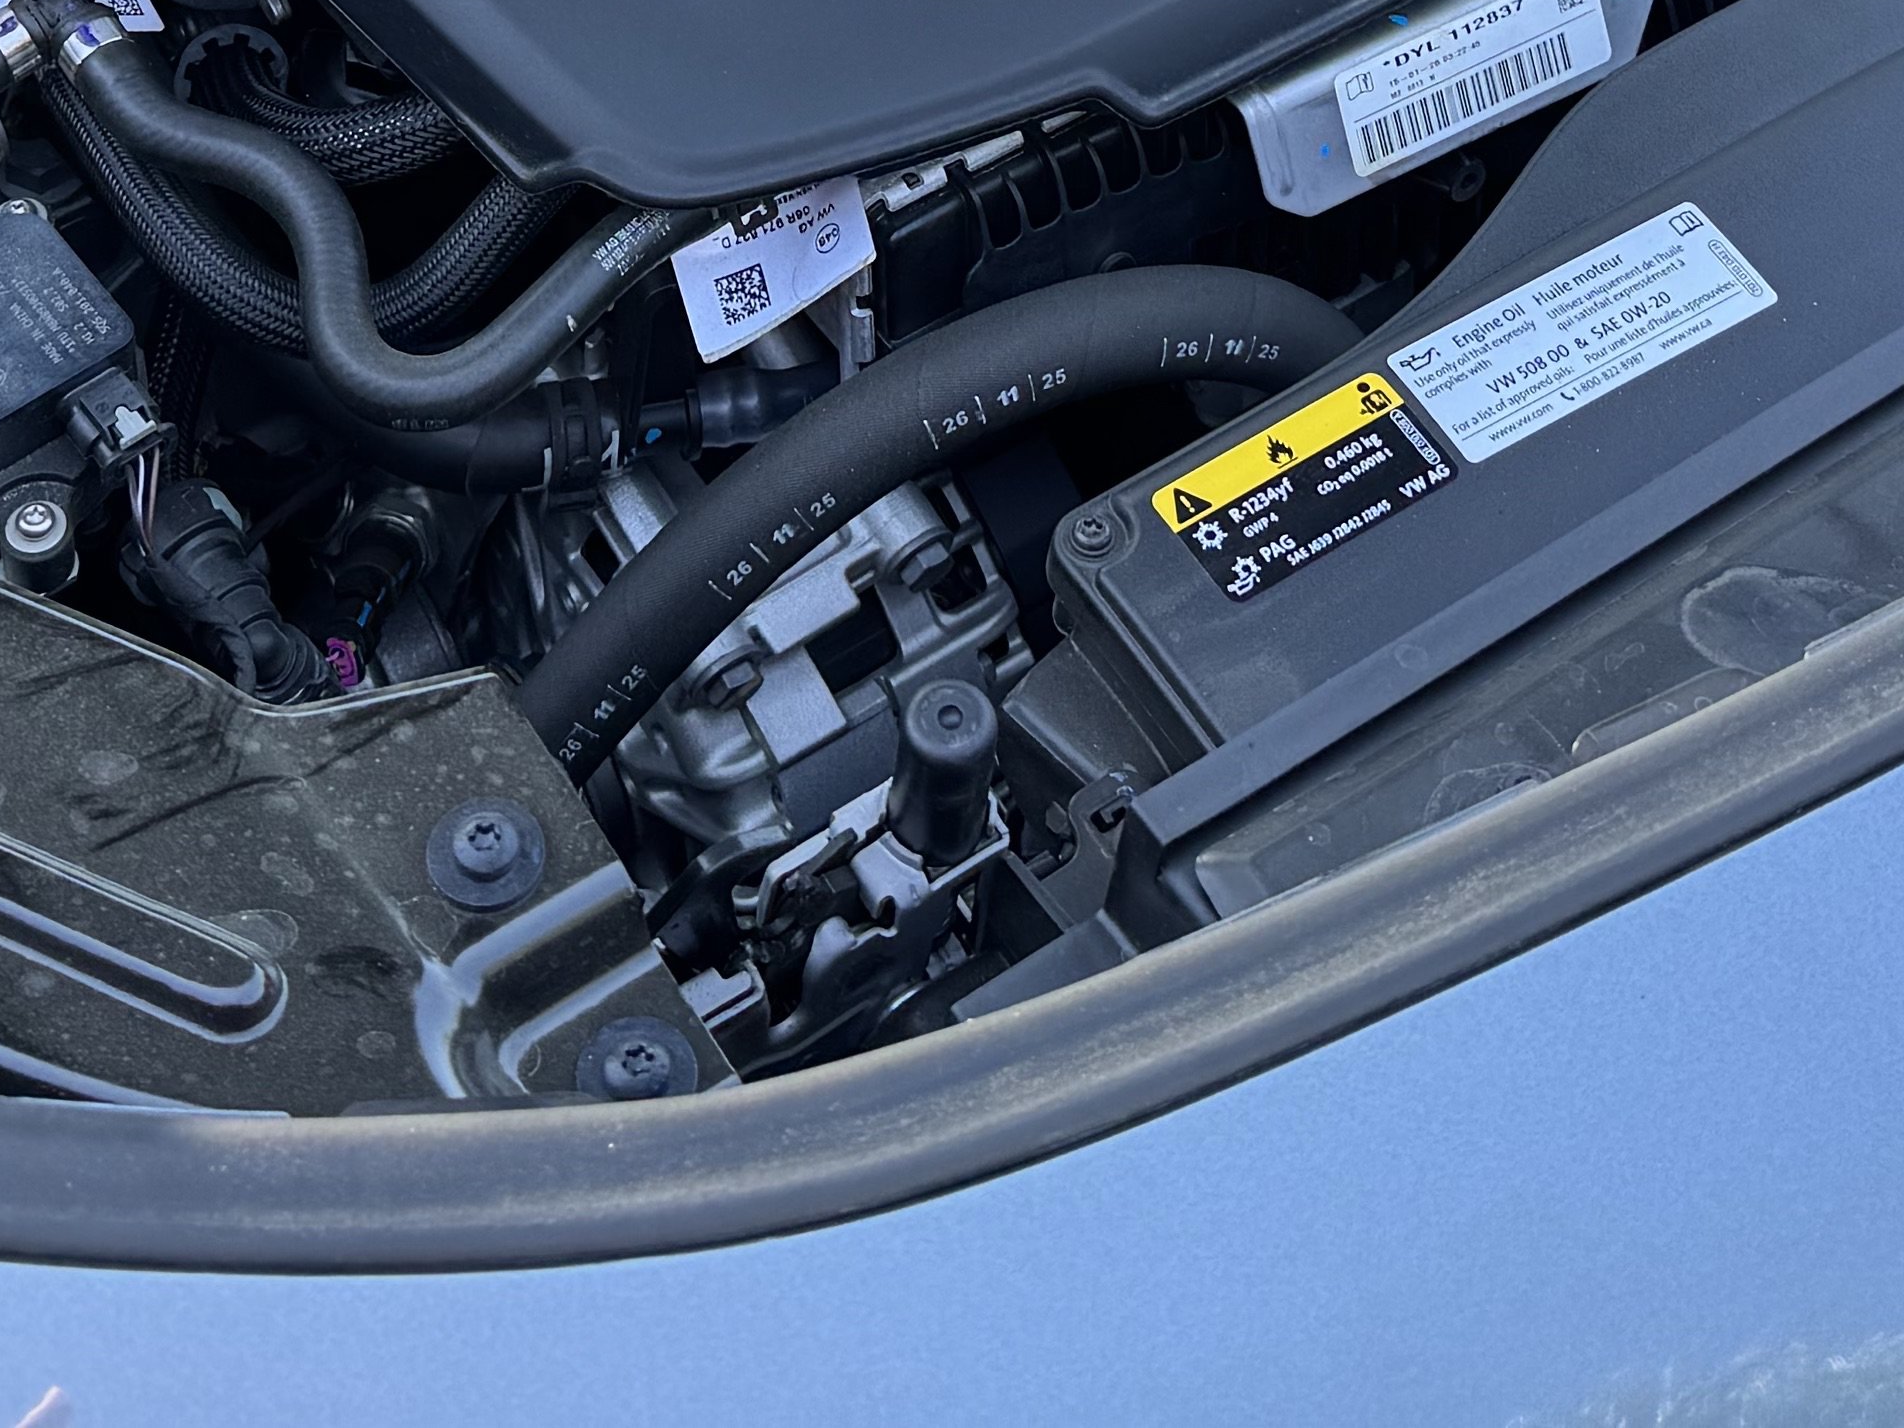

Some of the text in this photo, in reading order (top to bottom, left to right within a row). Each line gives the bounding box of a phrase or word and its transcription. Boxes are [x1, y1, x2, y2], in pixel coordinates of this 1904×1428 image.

[798, 203, 835, 233] VW AG
[1532, 255, 1623, 306] Huile moteur
[1546, 297, 1584, 320] Utilisez
[1584, 266, 1642, 301] uniquement
[1642, 260, 1655, 271] de
[1557, 259, 1686, 331] qui satisfait expressément à
[10, 303, 34, 328] CHINA
[32, 328, 45, 341] IN
[1452, 303, 1526, 348] Engine Oil
[41, 342, 63, 364] MADE
[1176, 341, 1198, 358] 26
[1258, 344, 1280, 360] 25
[1414, 321, 1537, 388] Use only oil that expressly
[1486, 292, 1671, 393] VW 508 00 & SAE 0W-20
[1584, 347, 1608, 364] Pour
[1608, 338, 1627, 352] une
[1625, 327, 1647, 341] liste
[942, 409, 969, 435] 26
[1041, 367, 1067, 390] 25
[1425, 360, 1493, 399] complies with
[1489, 404, 1553, 441] www.vw.com
[1660, 319, 1712, 350] www.vw.ca
[1452, 421, 1471, 435] For
[1477, 407, 1497, 421] list
[1495, 398, 1507, 412] of
[1508, 375, 1553, 406] approved
[1229, 478, 1293, 523] R-1234yf
[1324, 442, 1362, 469] 0.460
[1360, 434, 1383, 449] kg
[1399, 464, 1450, 497] VW AG
[726, 559, 754, 587] 26
[810, 491, 837, 517] 25
[1243, 517, 1269, 537] GWP
[1270, 512, 1279, 522] 4
[1259, 534, 1296, 562] PAG
[1287, 547, 1310, 566] SAE
[559, 734, 584, 762] 26
[621, 662, 648, 690] 25
